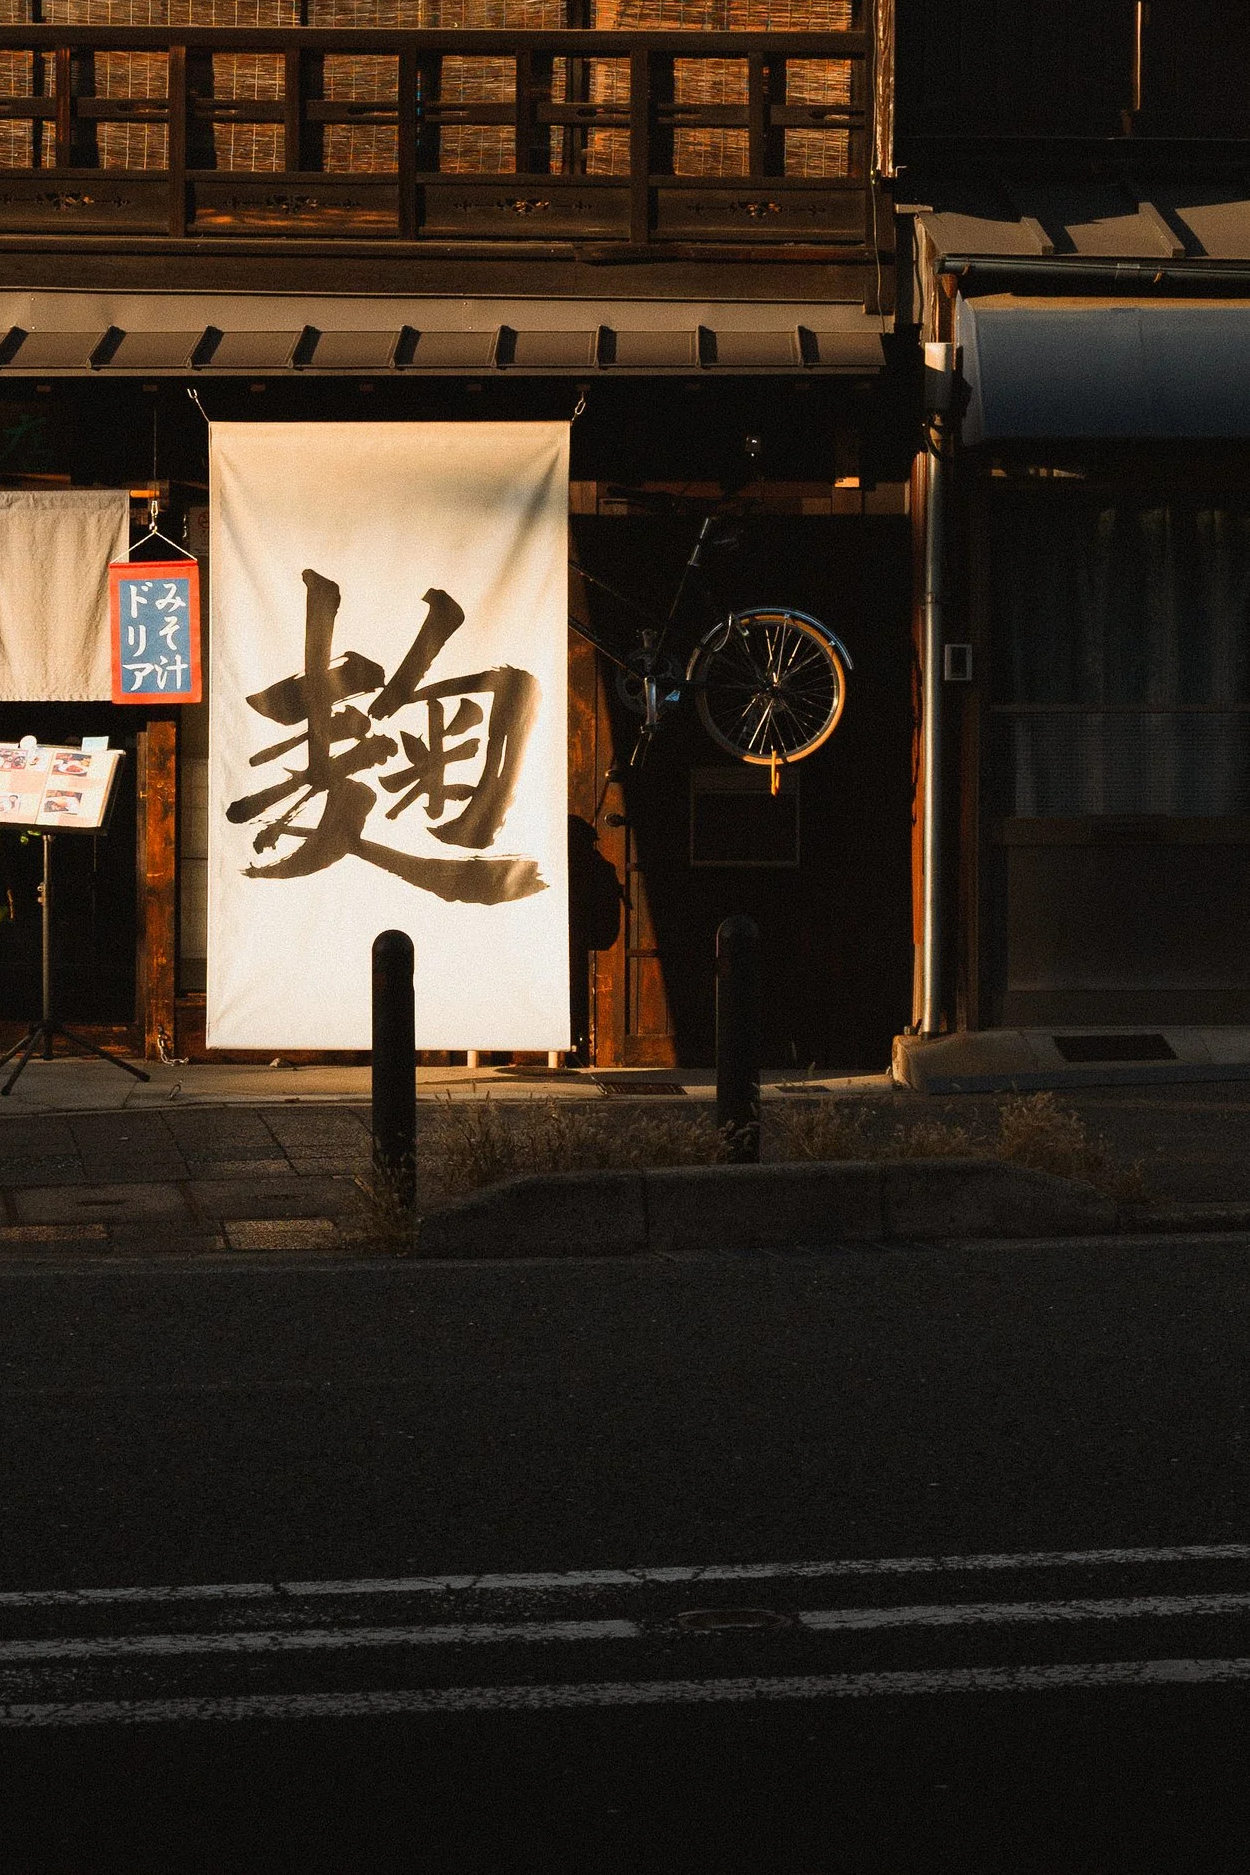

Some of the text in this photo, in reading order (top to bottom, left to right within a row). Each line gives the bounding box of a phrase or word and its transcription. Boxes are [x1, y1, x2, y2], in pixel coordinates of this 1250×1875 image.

[124, 581, 154, 693] ドリア
[154, 581, 189, 691] みそ汁
